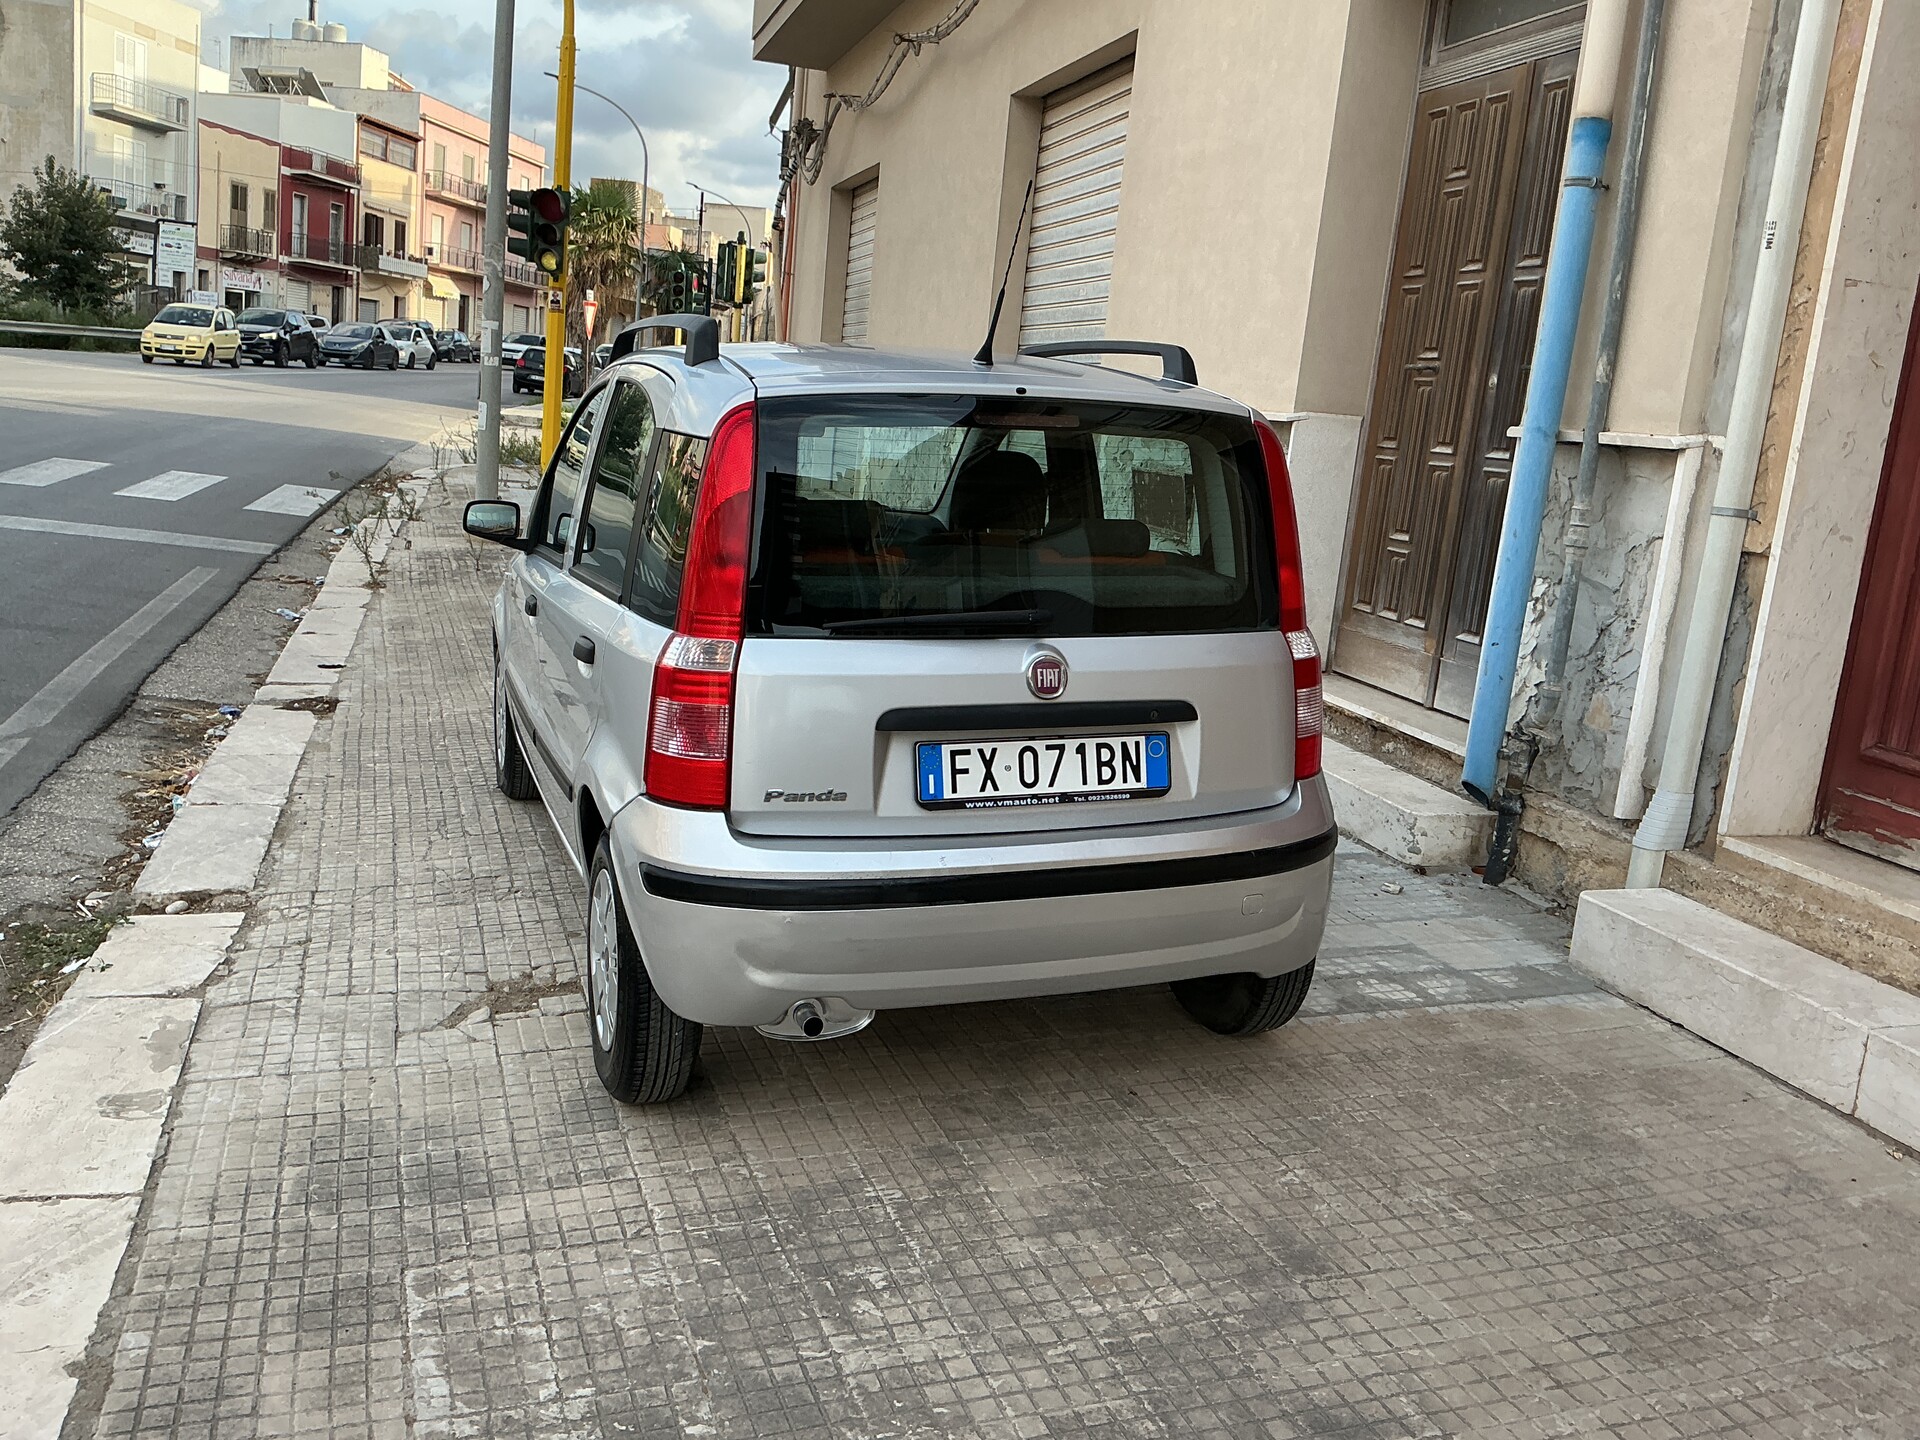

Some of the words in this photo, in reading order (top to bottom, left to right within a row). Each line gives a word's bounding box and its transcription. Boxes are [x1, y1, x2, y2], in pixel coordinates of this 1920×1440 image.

[224, 269, 253, 284] Silvana
[1037, 668, 1060, 688] FIAT
[949, 746, 1000, 794] FX
[1018, 741, 1142, 789] 071BN
[763, 787, 848, 803] Panda
[965, 796, 1060, 808] www.vmauto.net
